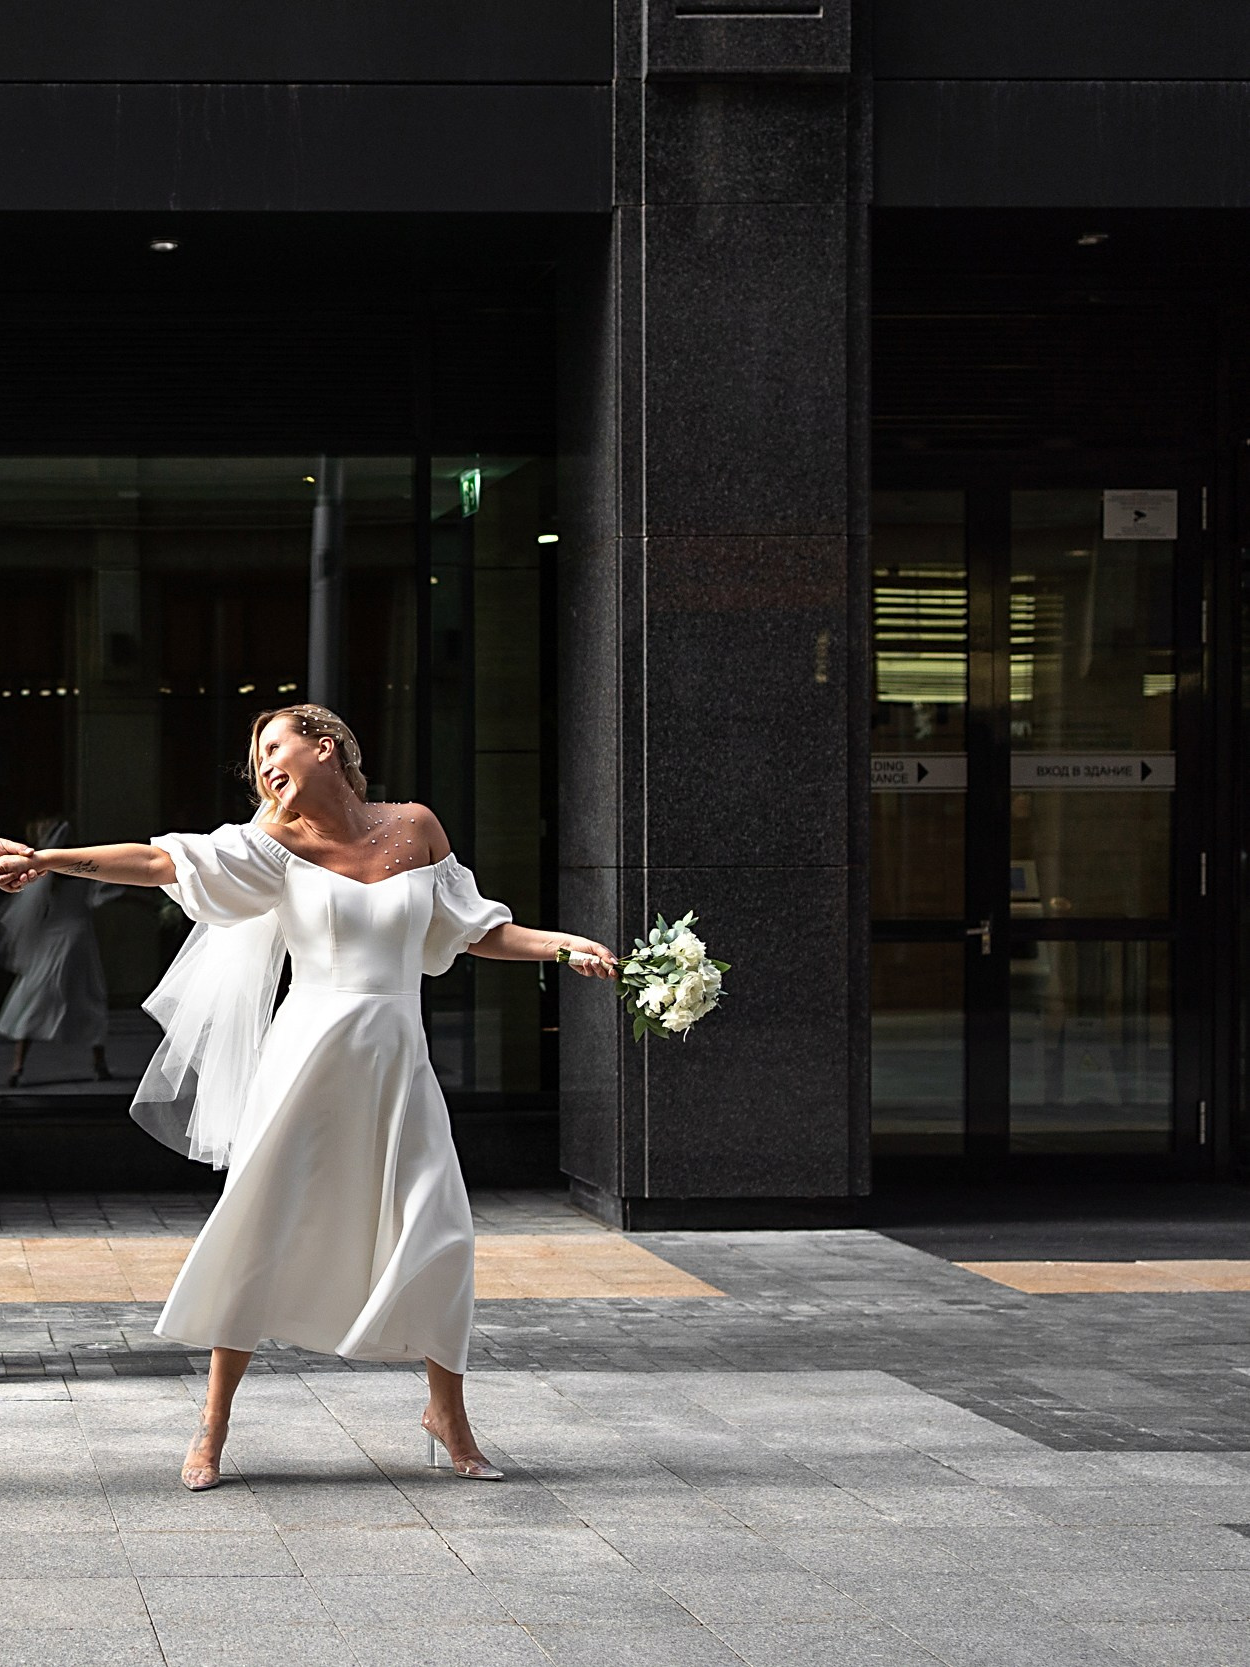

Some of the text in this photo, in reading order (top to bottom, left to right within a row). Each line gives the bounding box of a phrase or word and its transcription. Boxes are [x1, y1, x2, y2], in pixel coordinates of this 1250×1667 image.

[871, 760, 904, 772] DING
[1036, 765, 1133, 777] ВХОД В ЗДАНИЕ
